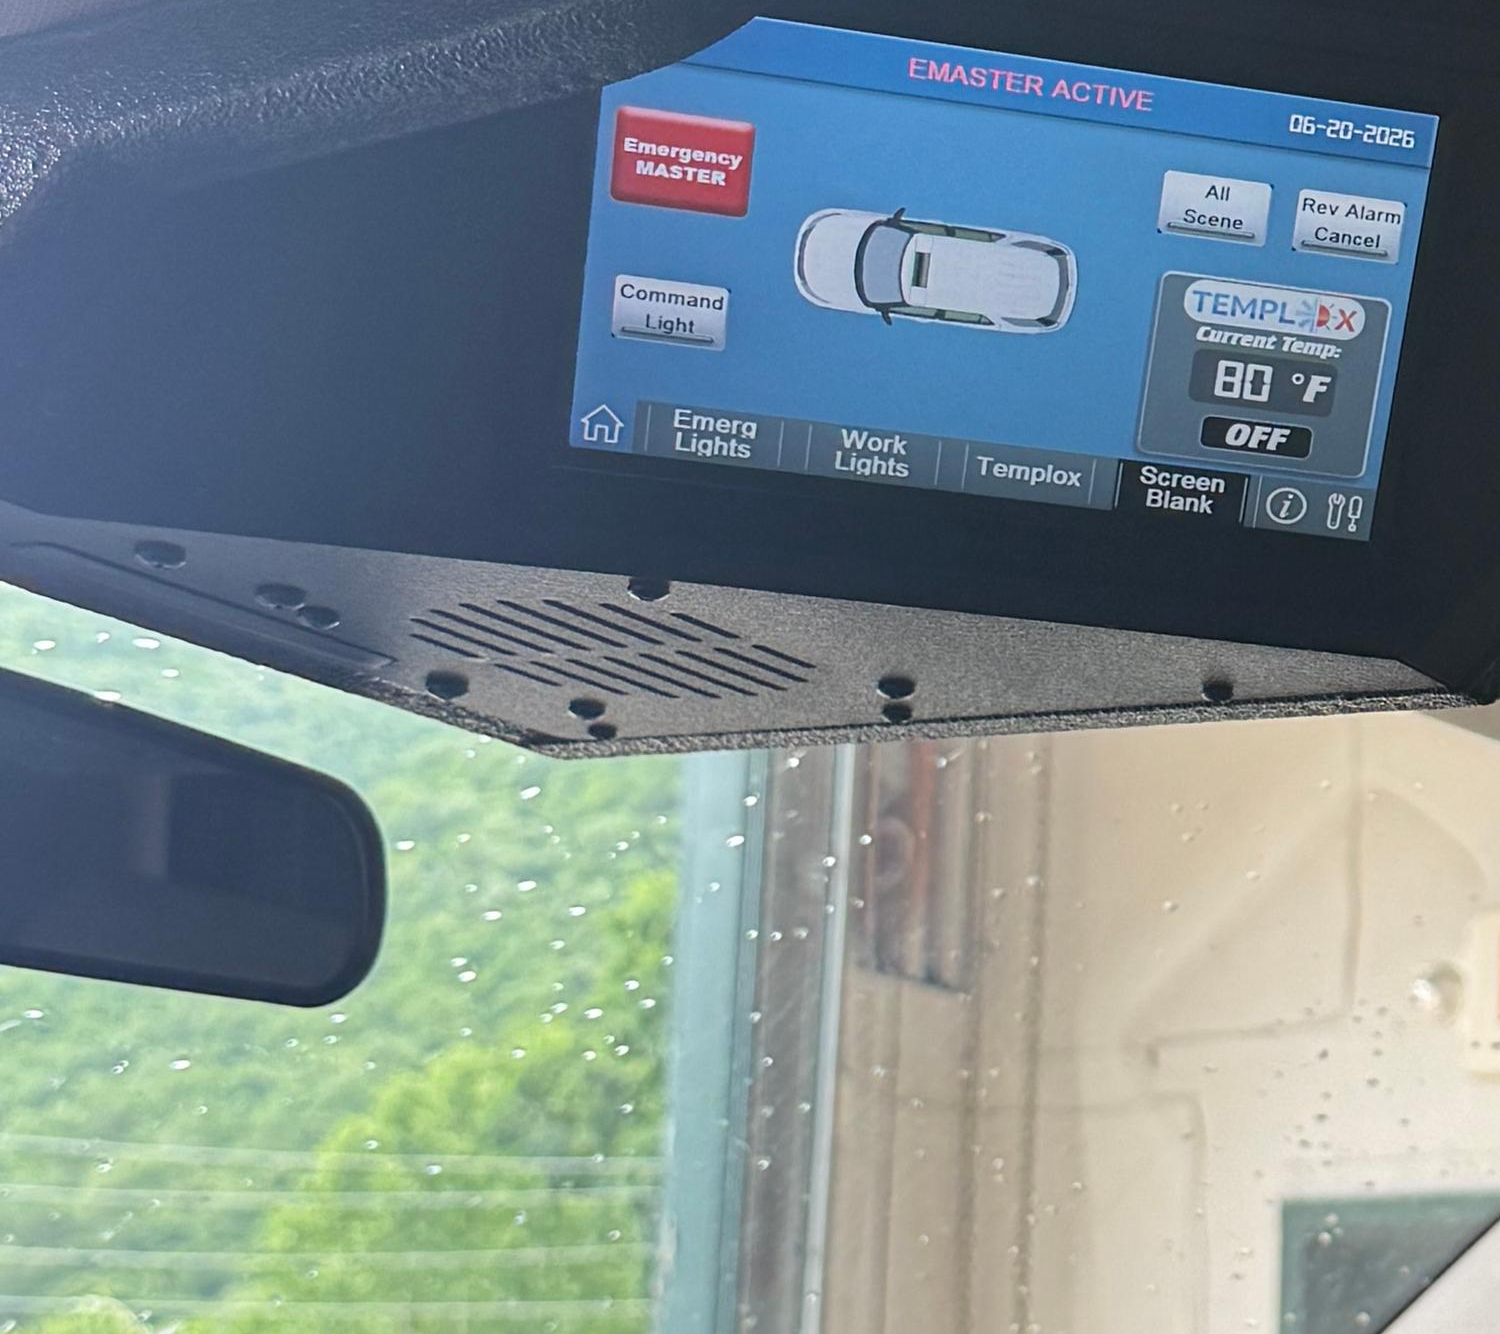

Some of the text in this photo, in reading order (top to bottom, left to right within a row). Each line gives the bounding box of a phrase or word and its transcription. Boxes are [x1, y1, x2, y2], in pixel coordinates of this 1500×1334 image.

[908, 58, 1155, 113] EMASTER ACTIVE
[1289, 114, 1416, 150] 06-20-2026
[623, 137, 743, 171] Emergency
[635, 160, 727, 186] MASTER
[1205, 185, 1231, 203] All
[1183, 208, 1244, 231] Scene
[1302, 198, 1402, 226] Rev Alarm
[1313, 226, 1381, 249] Cancel
[620, 283, 724, 310] Command
[645, 313, 696, 335] Light
[1196, 326, 1343, 360] Current Temp:
[1213, 359, 1273, 403] 80
[673, 408, 758, 440] Emerg
[1225, 423, 1291, 452] OFF
[675, 431, 751, 459] Lights
[841, 428, 908, 457] Work
[834, 450, 910, 479] Lights
[976, 455, 1082, 489] Templox
[1139, 464, 1226, 494] Screen
[1145, 488, 1214, 515] Blank
